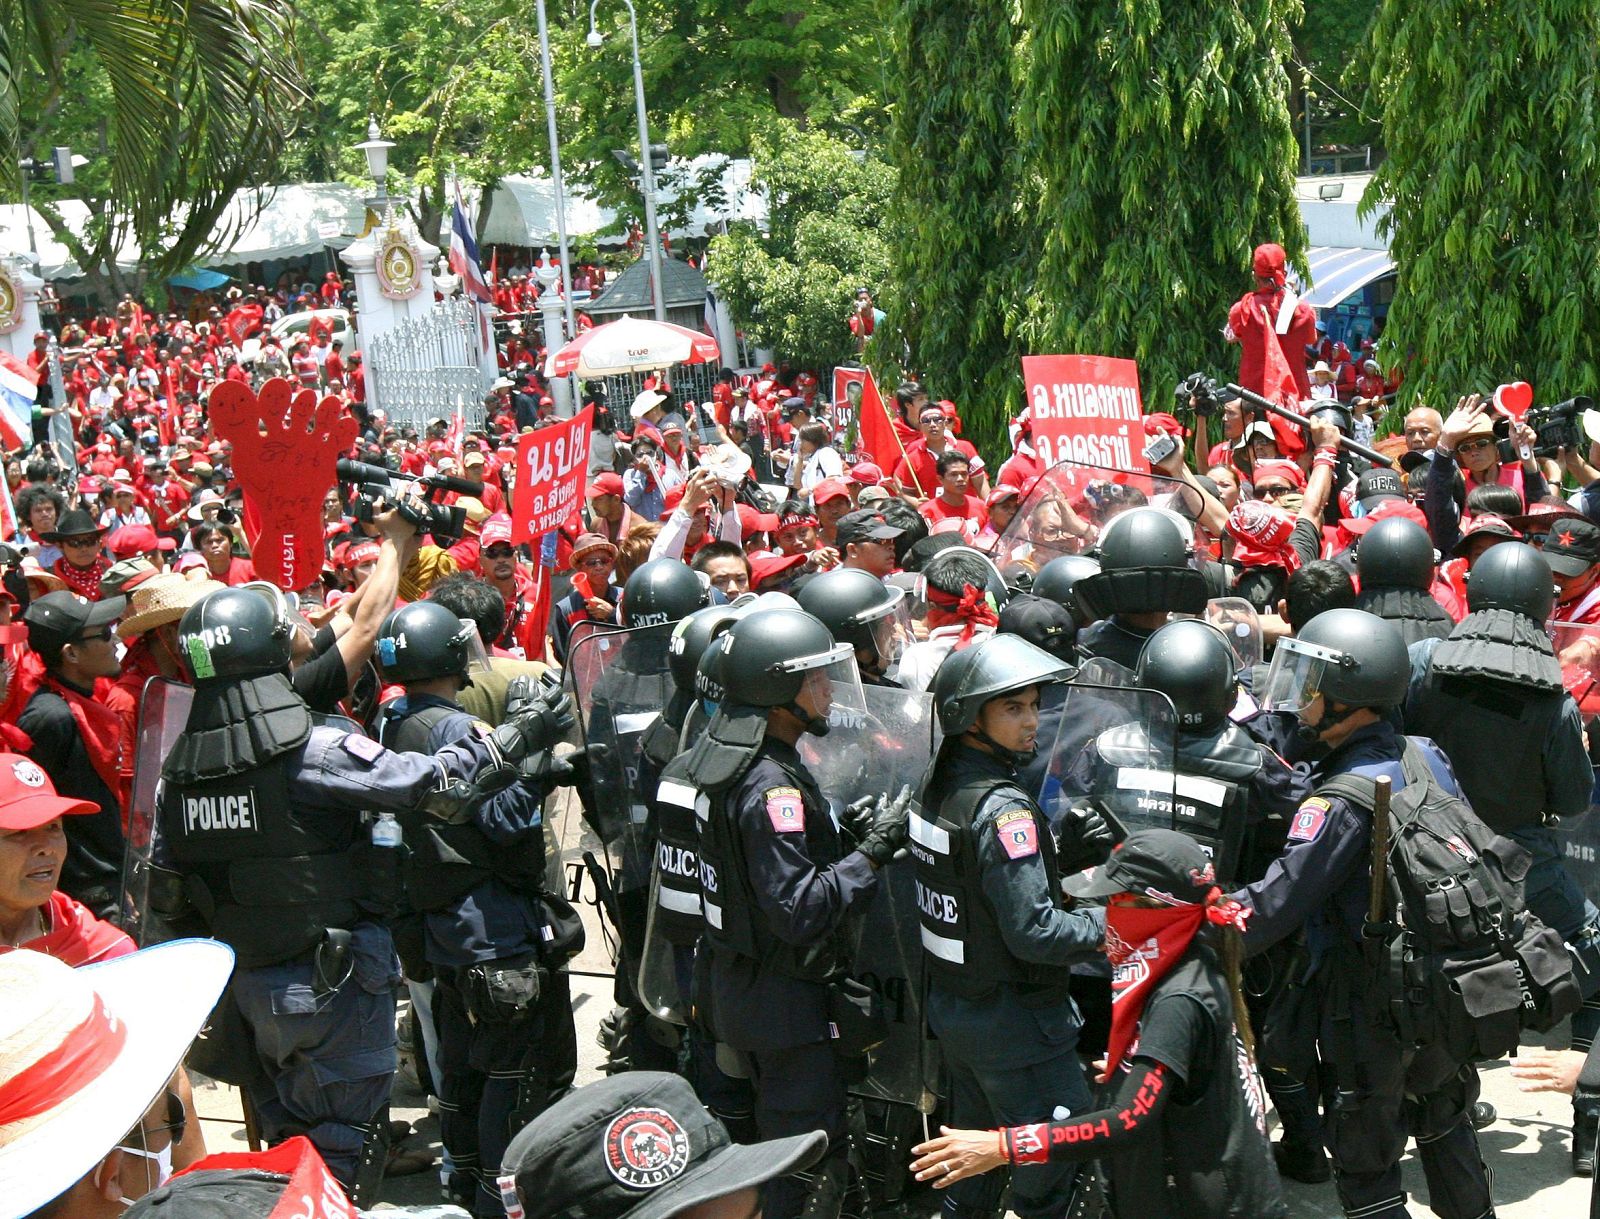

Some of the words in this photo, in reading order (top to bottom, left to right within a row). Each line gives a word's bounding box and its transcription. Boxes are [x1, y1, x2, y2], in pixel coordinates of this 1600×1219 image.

[628, 348, 649, 357] true
[1032, 383, 1140, 421] อ.หนองหาน
[186, 795, 252, 831] POLICE
[608, 1143, 624, 1169] THE
[617, 1133, 687, 1184] GLADIATOR
